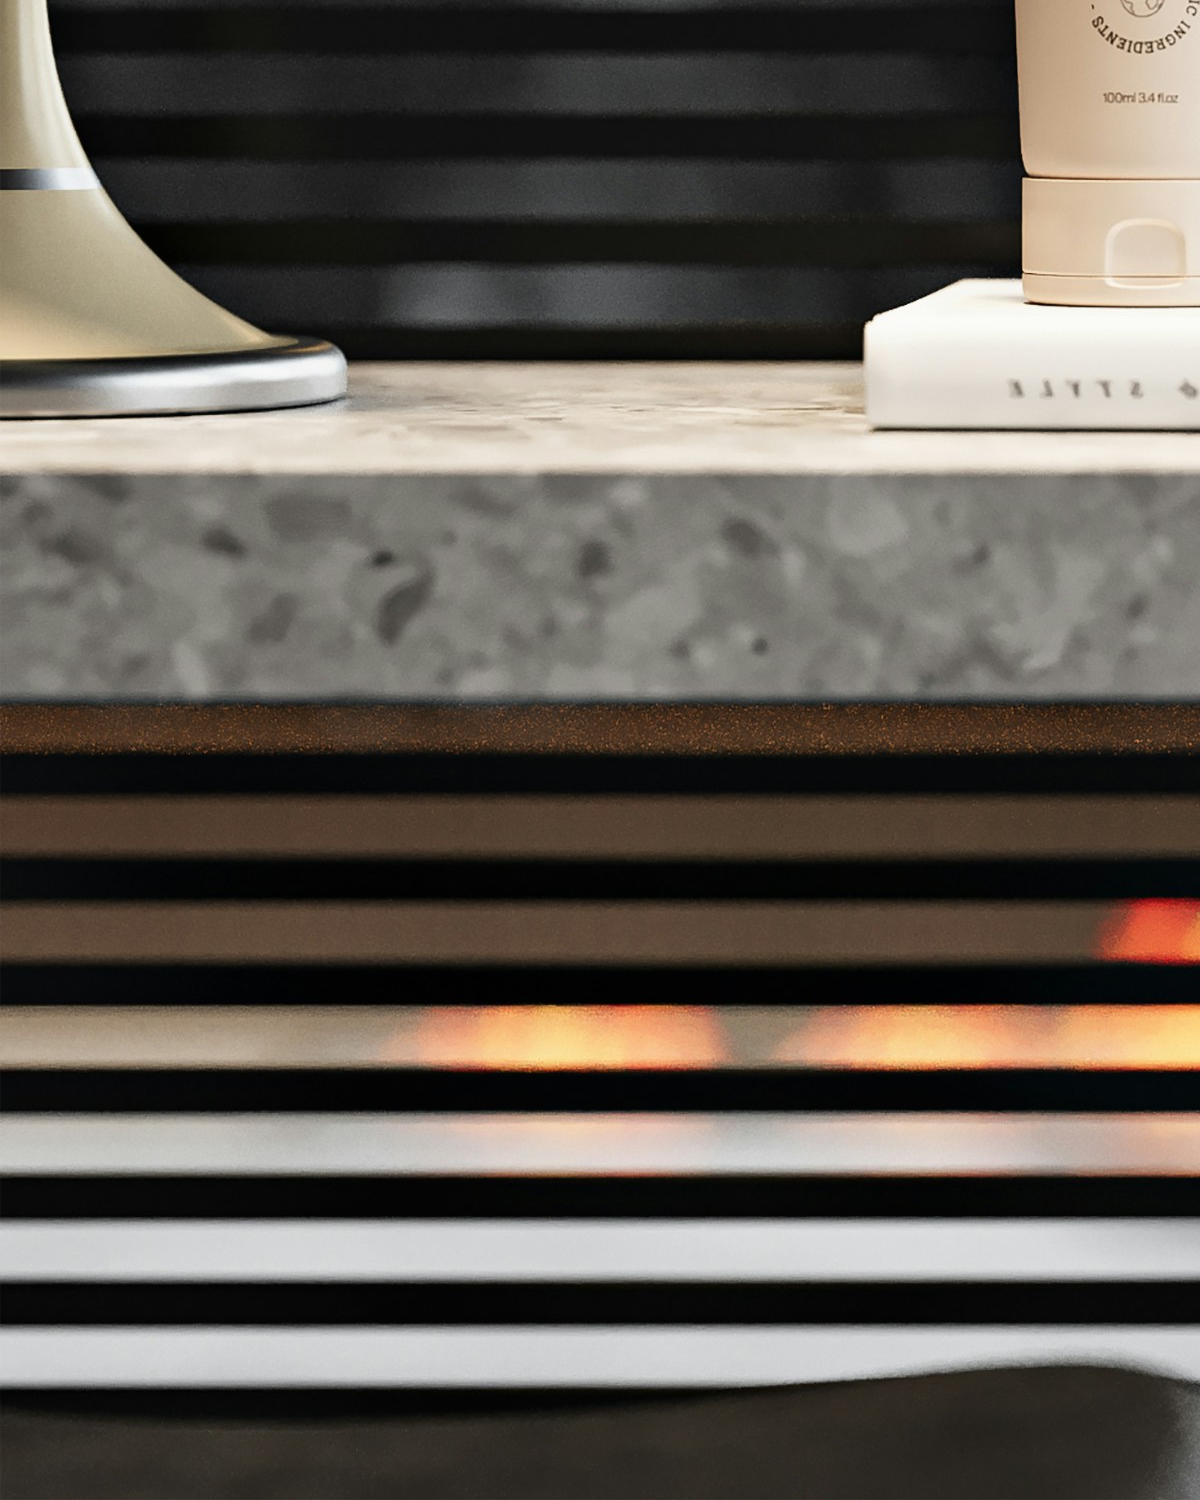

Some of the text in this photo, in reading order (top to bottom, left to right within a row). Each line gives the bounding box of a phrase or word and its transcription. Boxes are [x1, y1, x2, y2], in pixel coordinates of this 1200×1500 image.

[1091, 15, 1191, 54] INGREDIENTS
[1102, 92, 1136, 104] 100ml
[1138, 92, 1155, 103] 3.4
